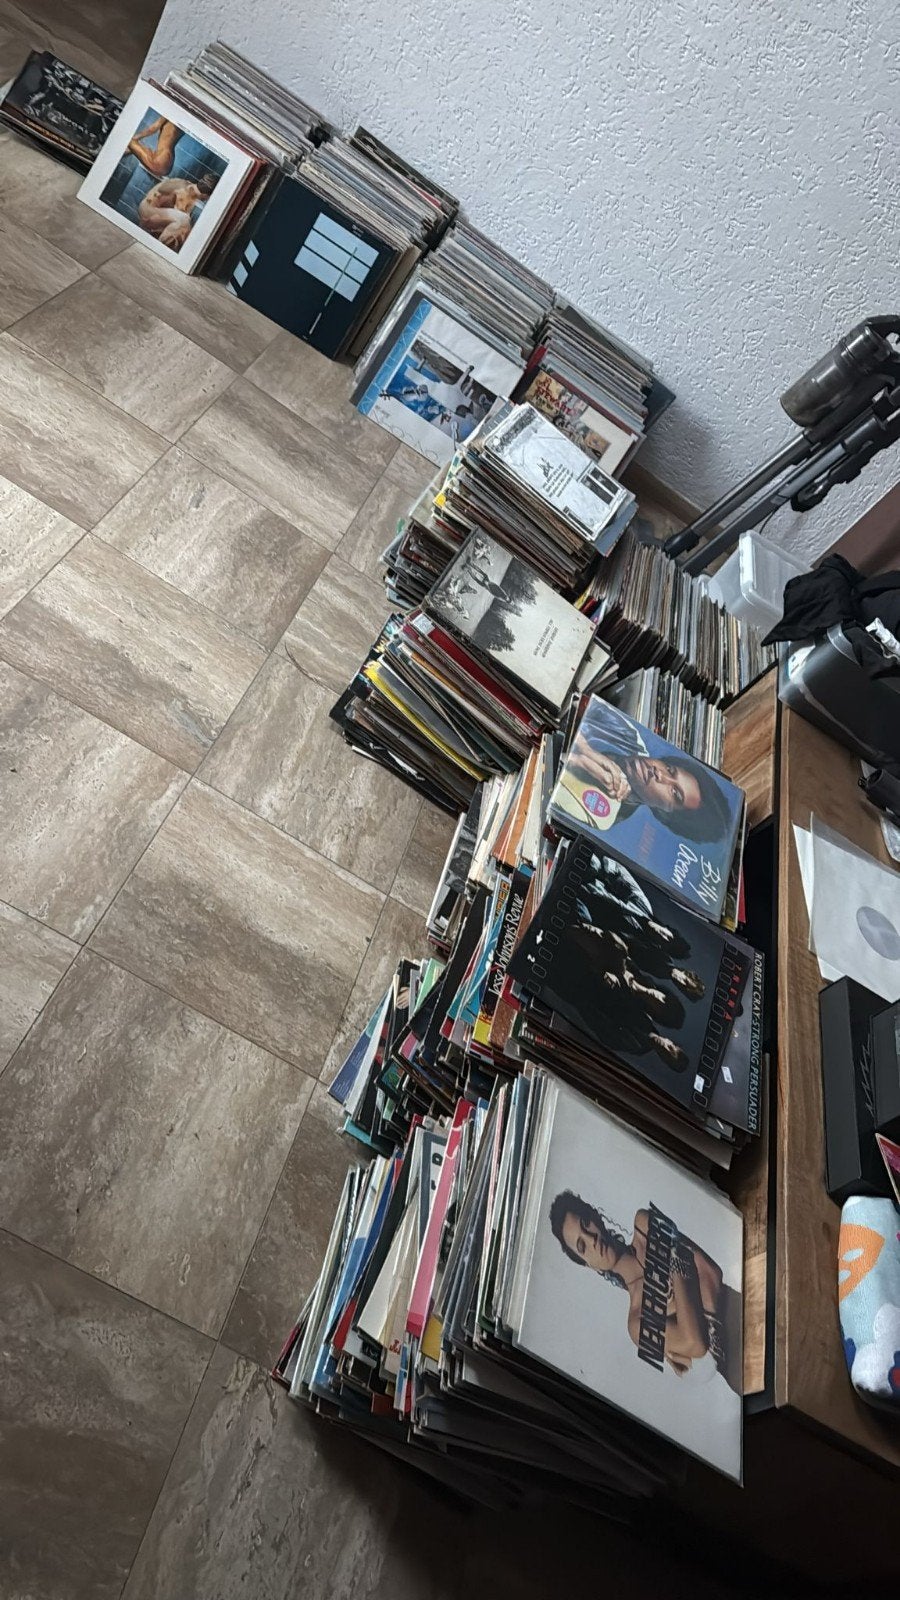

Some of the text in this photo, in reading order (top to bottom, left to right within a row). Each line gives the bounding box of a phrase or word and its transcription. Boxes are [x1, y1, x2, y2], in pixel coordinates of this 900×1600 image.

[671, 843, 698, 889] Ocean
[688, 854, 721, 906] Billy
[505, 893, 524, 926] Revue
[495, 925, 518, 971] Johnson's
[488, 969, 505, 996] Jesse
[753, 952, 763, 991] ROBERT
[748, 1066, 761, 1130] PERSUADER
[637, 1289, 669, 1373] NENEH
